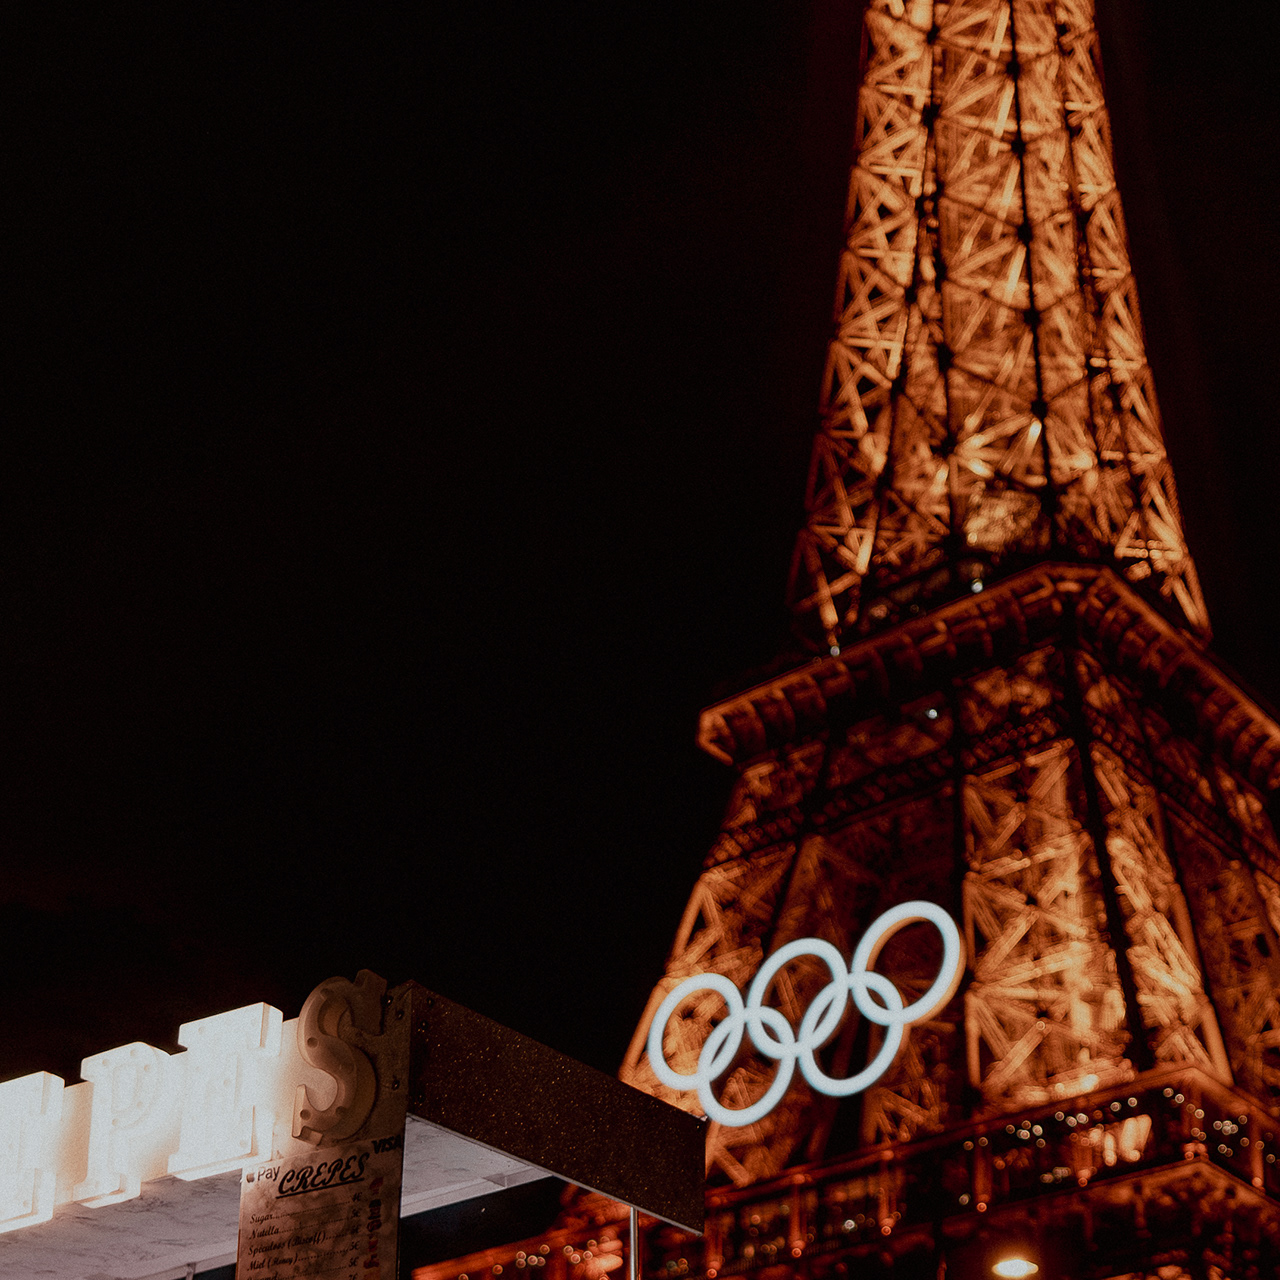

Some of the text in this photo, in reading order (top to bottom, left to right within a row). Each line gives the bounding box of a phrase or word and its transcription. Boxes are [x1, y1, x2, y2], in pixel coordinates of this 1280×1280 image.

[371, 1134, 402, 1154] VISA
[257, 1166, 281, 1182] Pay
[278, 1152, 370, 1195] CREPES
[249, 1213, 273, 1225] Sugar
[248, 1225, 279, 1240] Nutella
[247, 1258, 266, 1272] Miel
